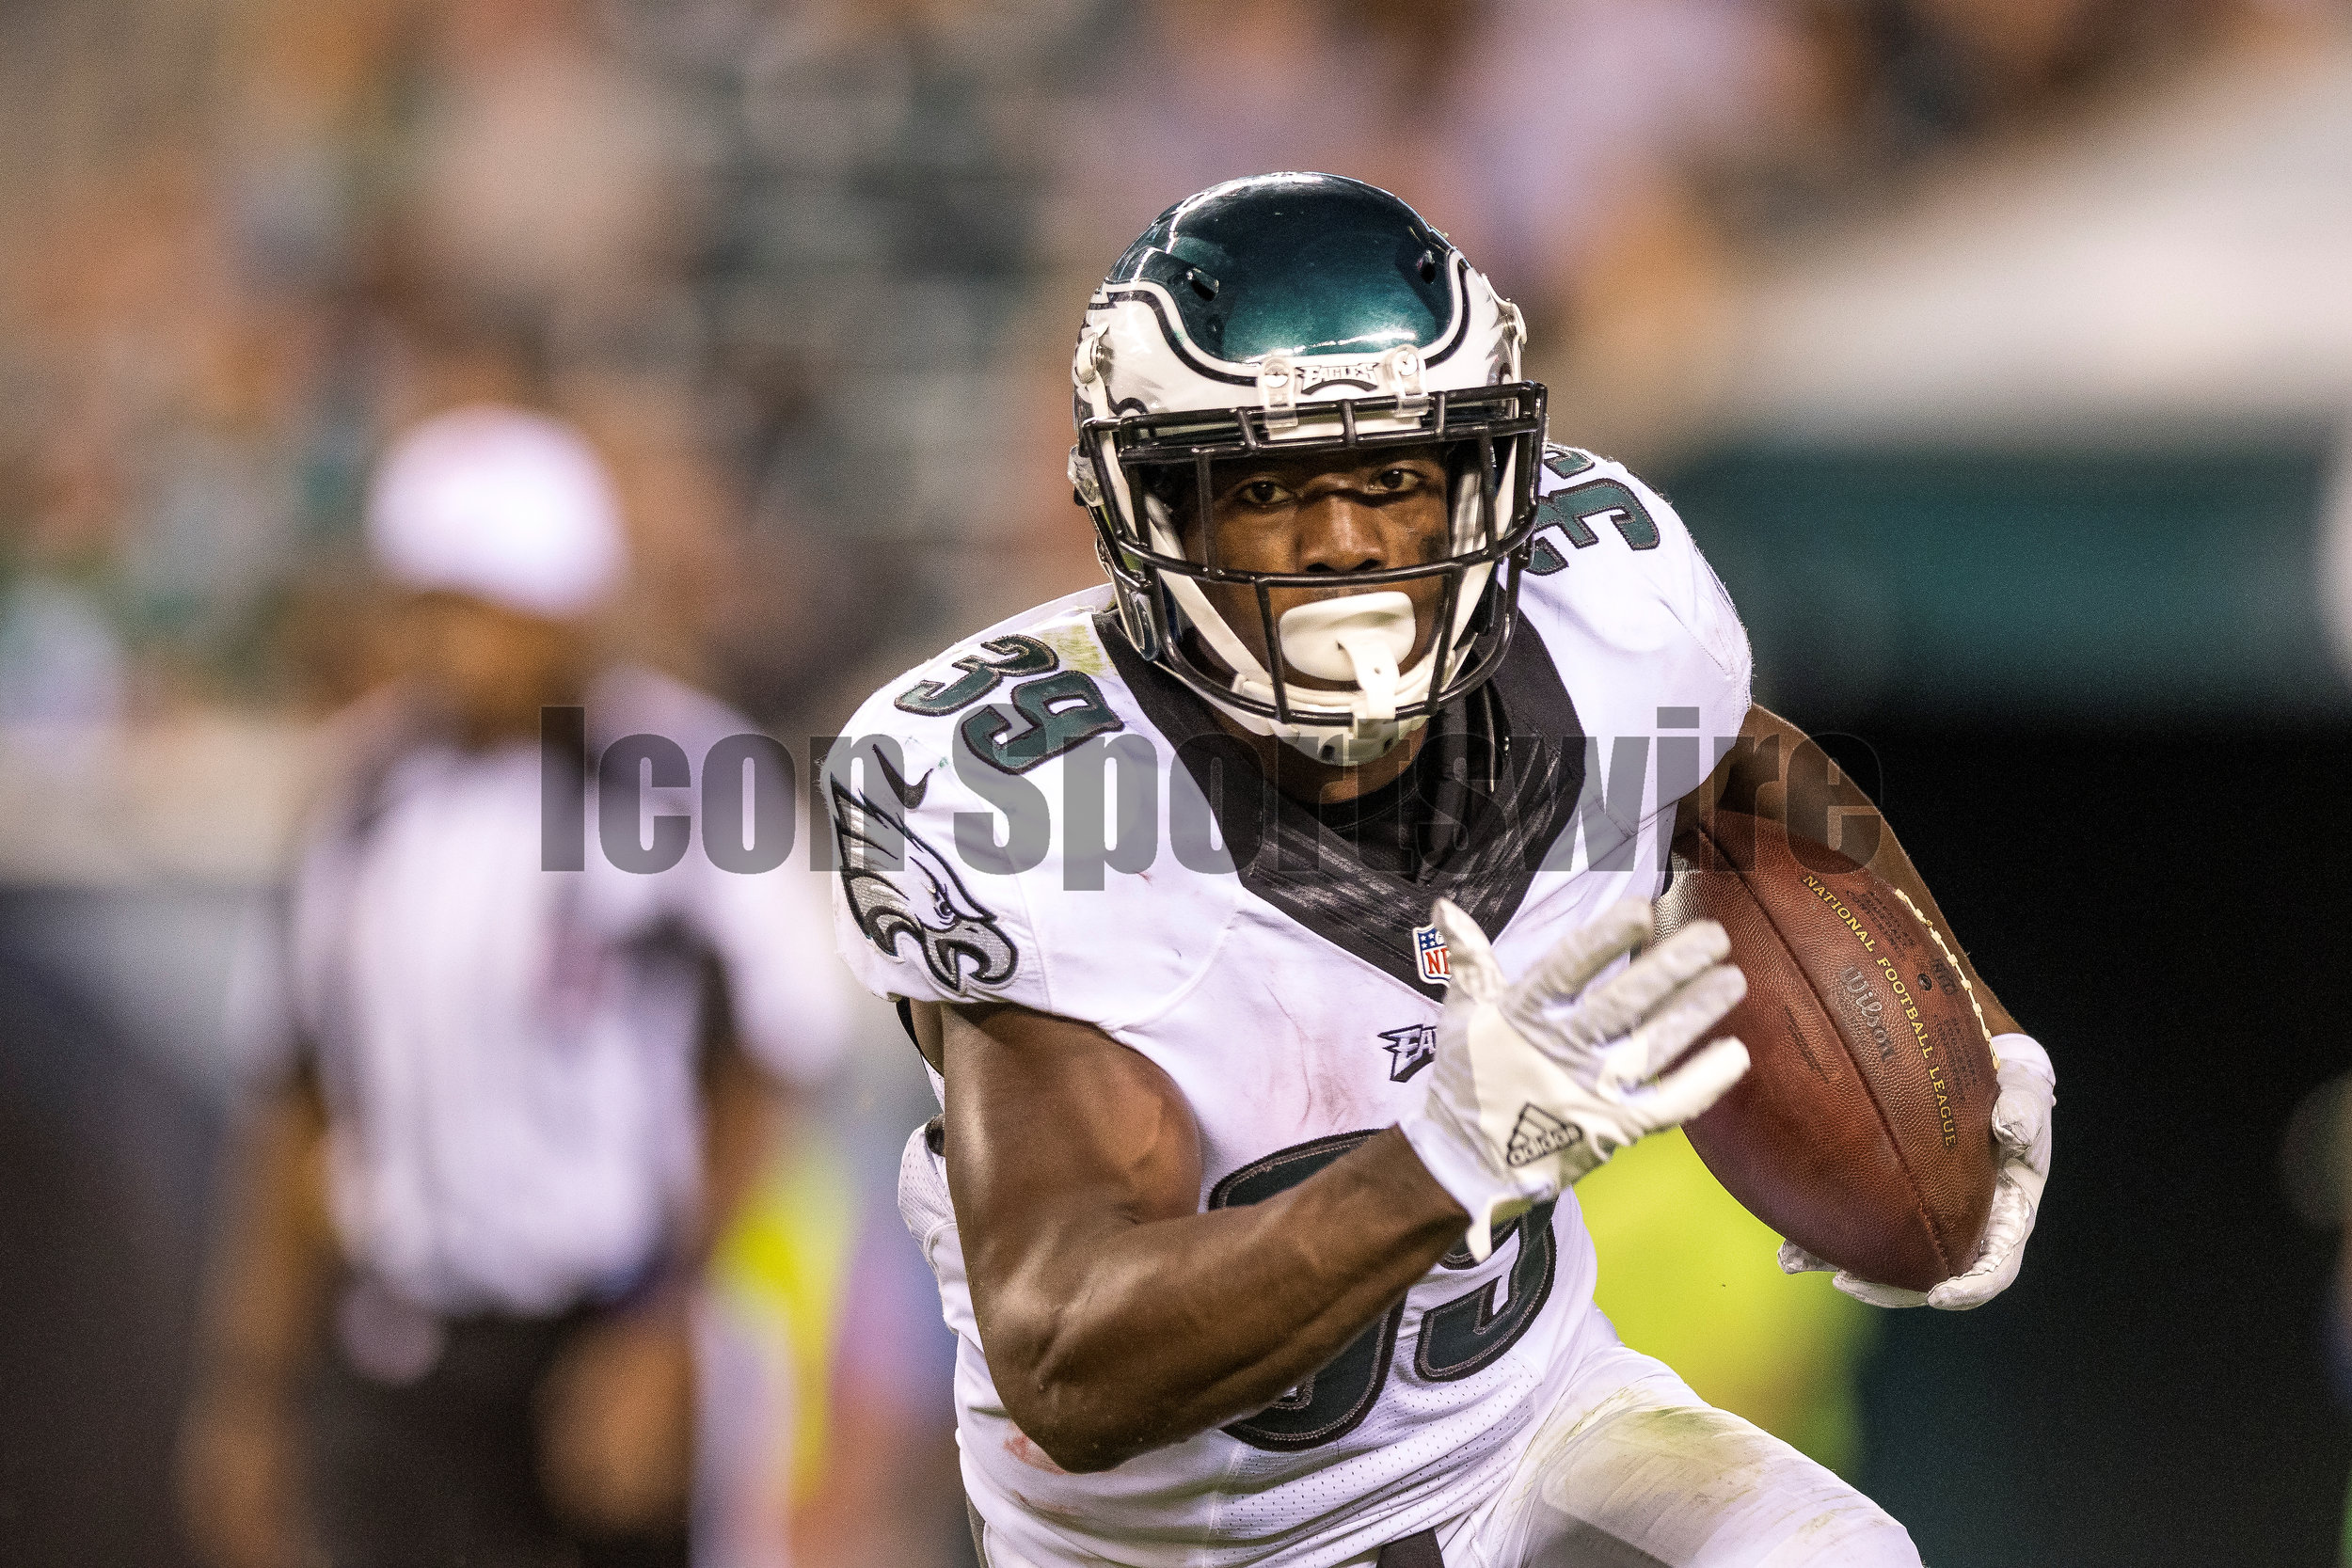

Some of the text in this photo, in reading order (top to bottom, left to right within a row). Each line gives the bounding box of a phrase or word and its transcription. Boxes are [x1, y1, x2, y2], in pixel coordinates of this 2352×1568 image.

[894, 634, 1125, 775] 39
[1803, 874, 1876, 952] NATIONAL
[1876, 957, 1932, 1059] FOOTBALL
[1929, 1067, 1958, 1148] LEAGUE
[1840, 965, 1894, 1062] Wilson
